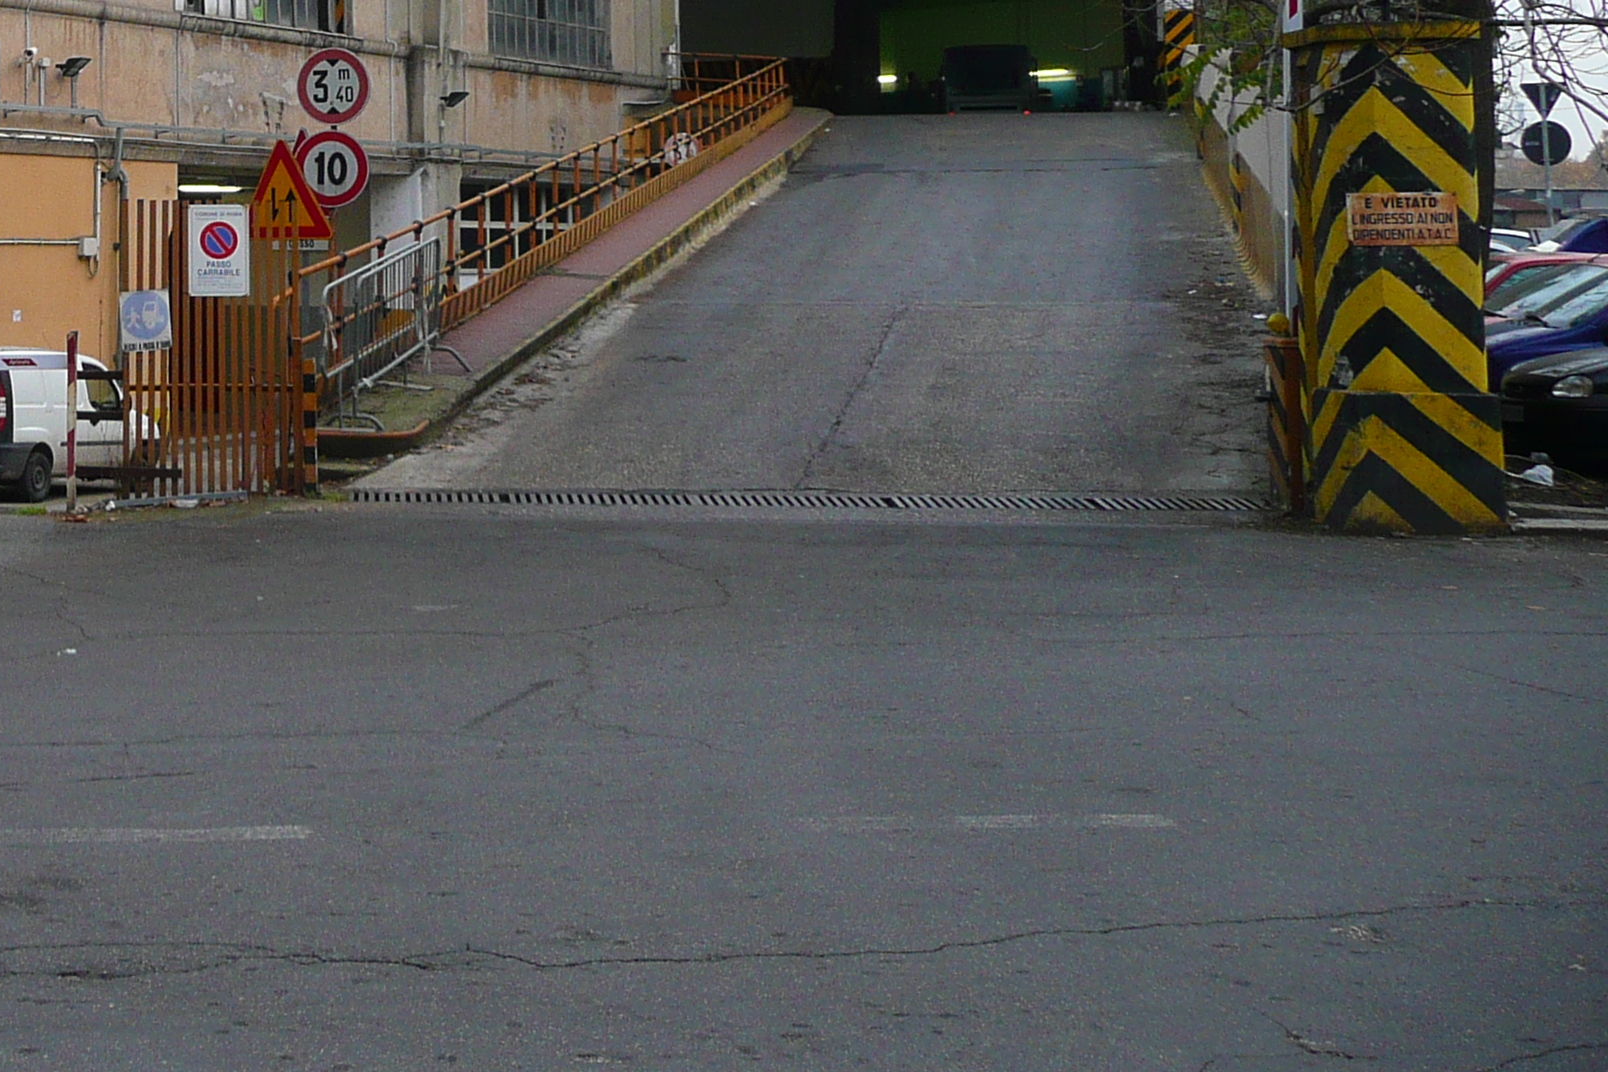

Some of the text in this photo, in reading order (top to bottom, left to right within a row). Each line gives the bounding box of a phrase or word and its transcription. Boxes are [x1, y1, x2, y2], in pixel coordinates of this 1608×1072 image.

[313, 69, 354, 103] 3 m 40
[315, 151, 348, 185] 10
[1381, 197, 1437, 208] VIETATO
[1430, 212, 1453, 224] NON
[1353, 229, 1415, 241] DIPENDENTI
[206, 260, 232, 268] PASSO
